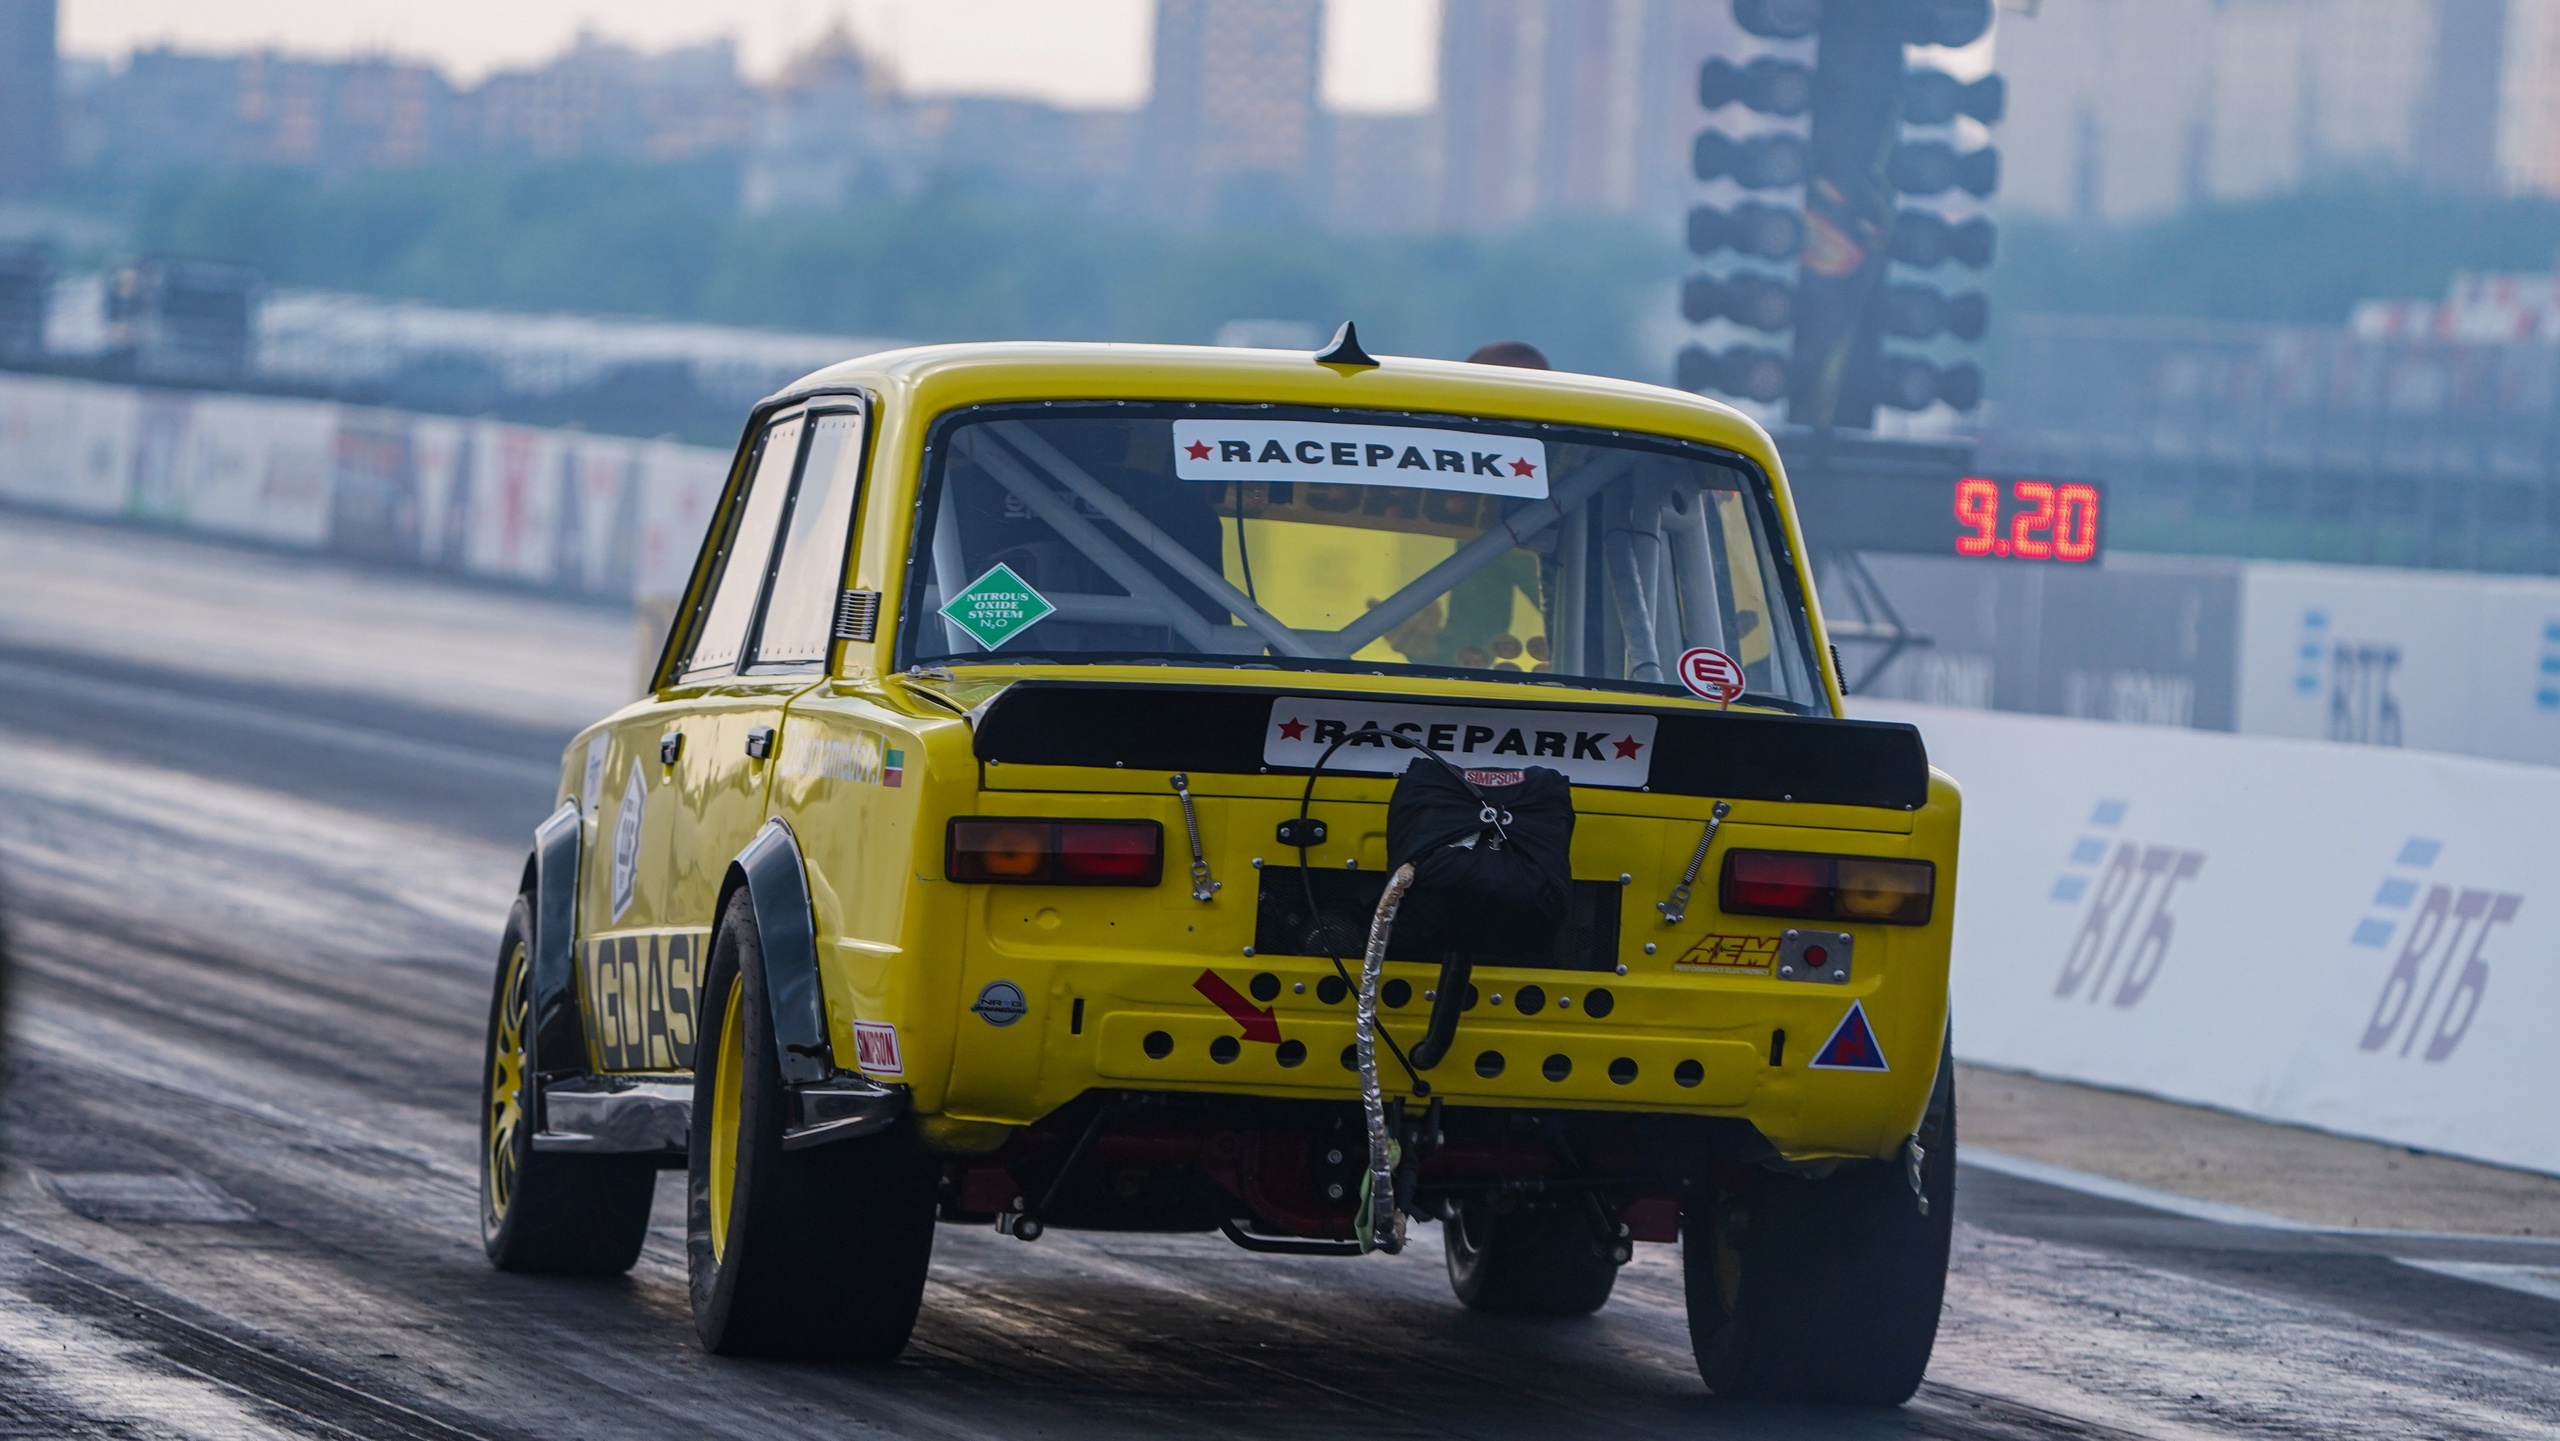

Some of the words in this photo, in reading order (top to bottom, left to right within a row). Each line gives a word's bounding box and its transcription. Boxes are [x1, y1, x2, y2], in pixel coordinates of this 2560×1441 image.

[1218, 439, 1505, 478] RACEPARK
[1955, 478, 2098, 562] 9.20
[966, 592, 1029, 602] NITROUS
[968, 610, 1024, 619] SYSTEM
[974, 601, 1019, 610] OXIDE
[1693, 658, 1730, 683] E
[1312, 719, 1610, 762] RACEPARK
[1467, 771, 1520, 785] SIMPSON
[2054, 841, 2206, 1007] ВТБ
[1676, 934, 1783, 968] AEM
[2358, 884, 2524, 1062] ВТБ
[857, 1029, 896, 1066] SIMPSON
